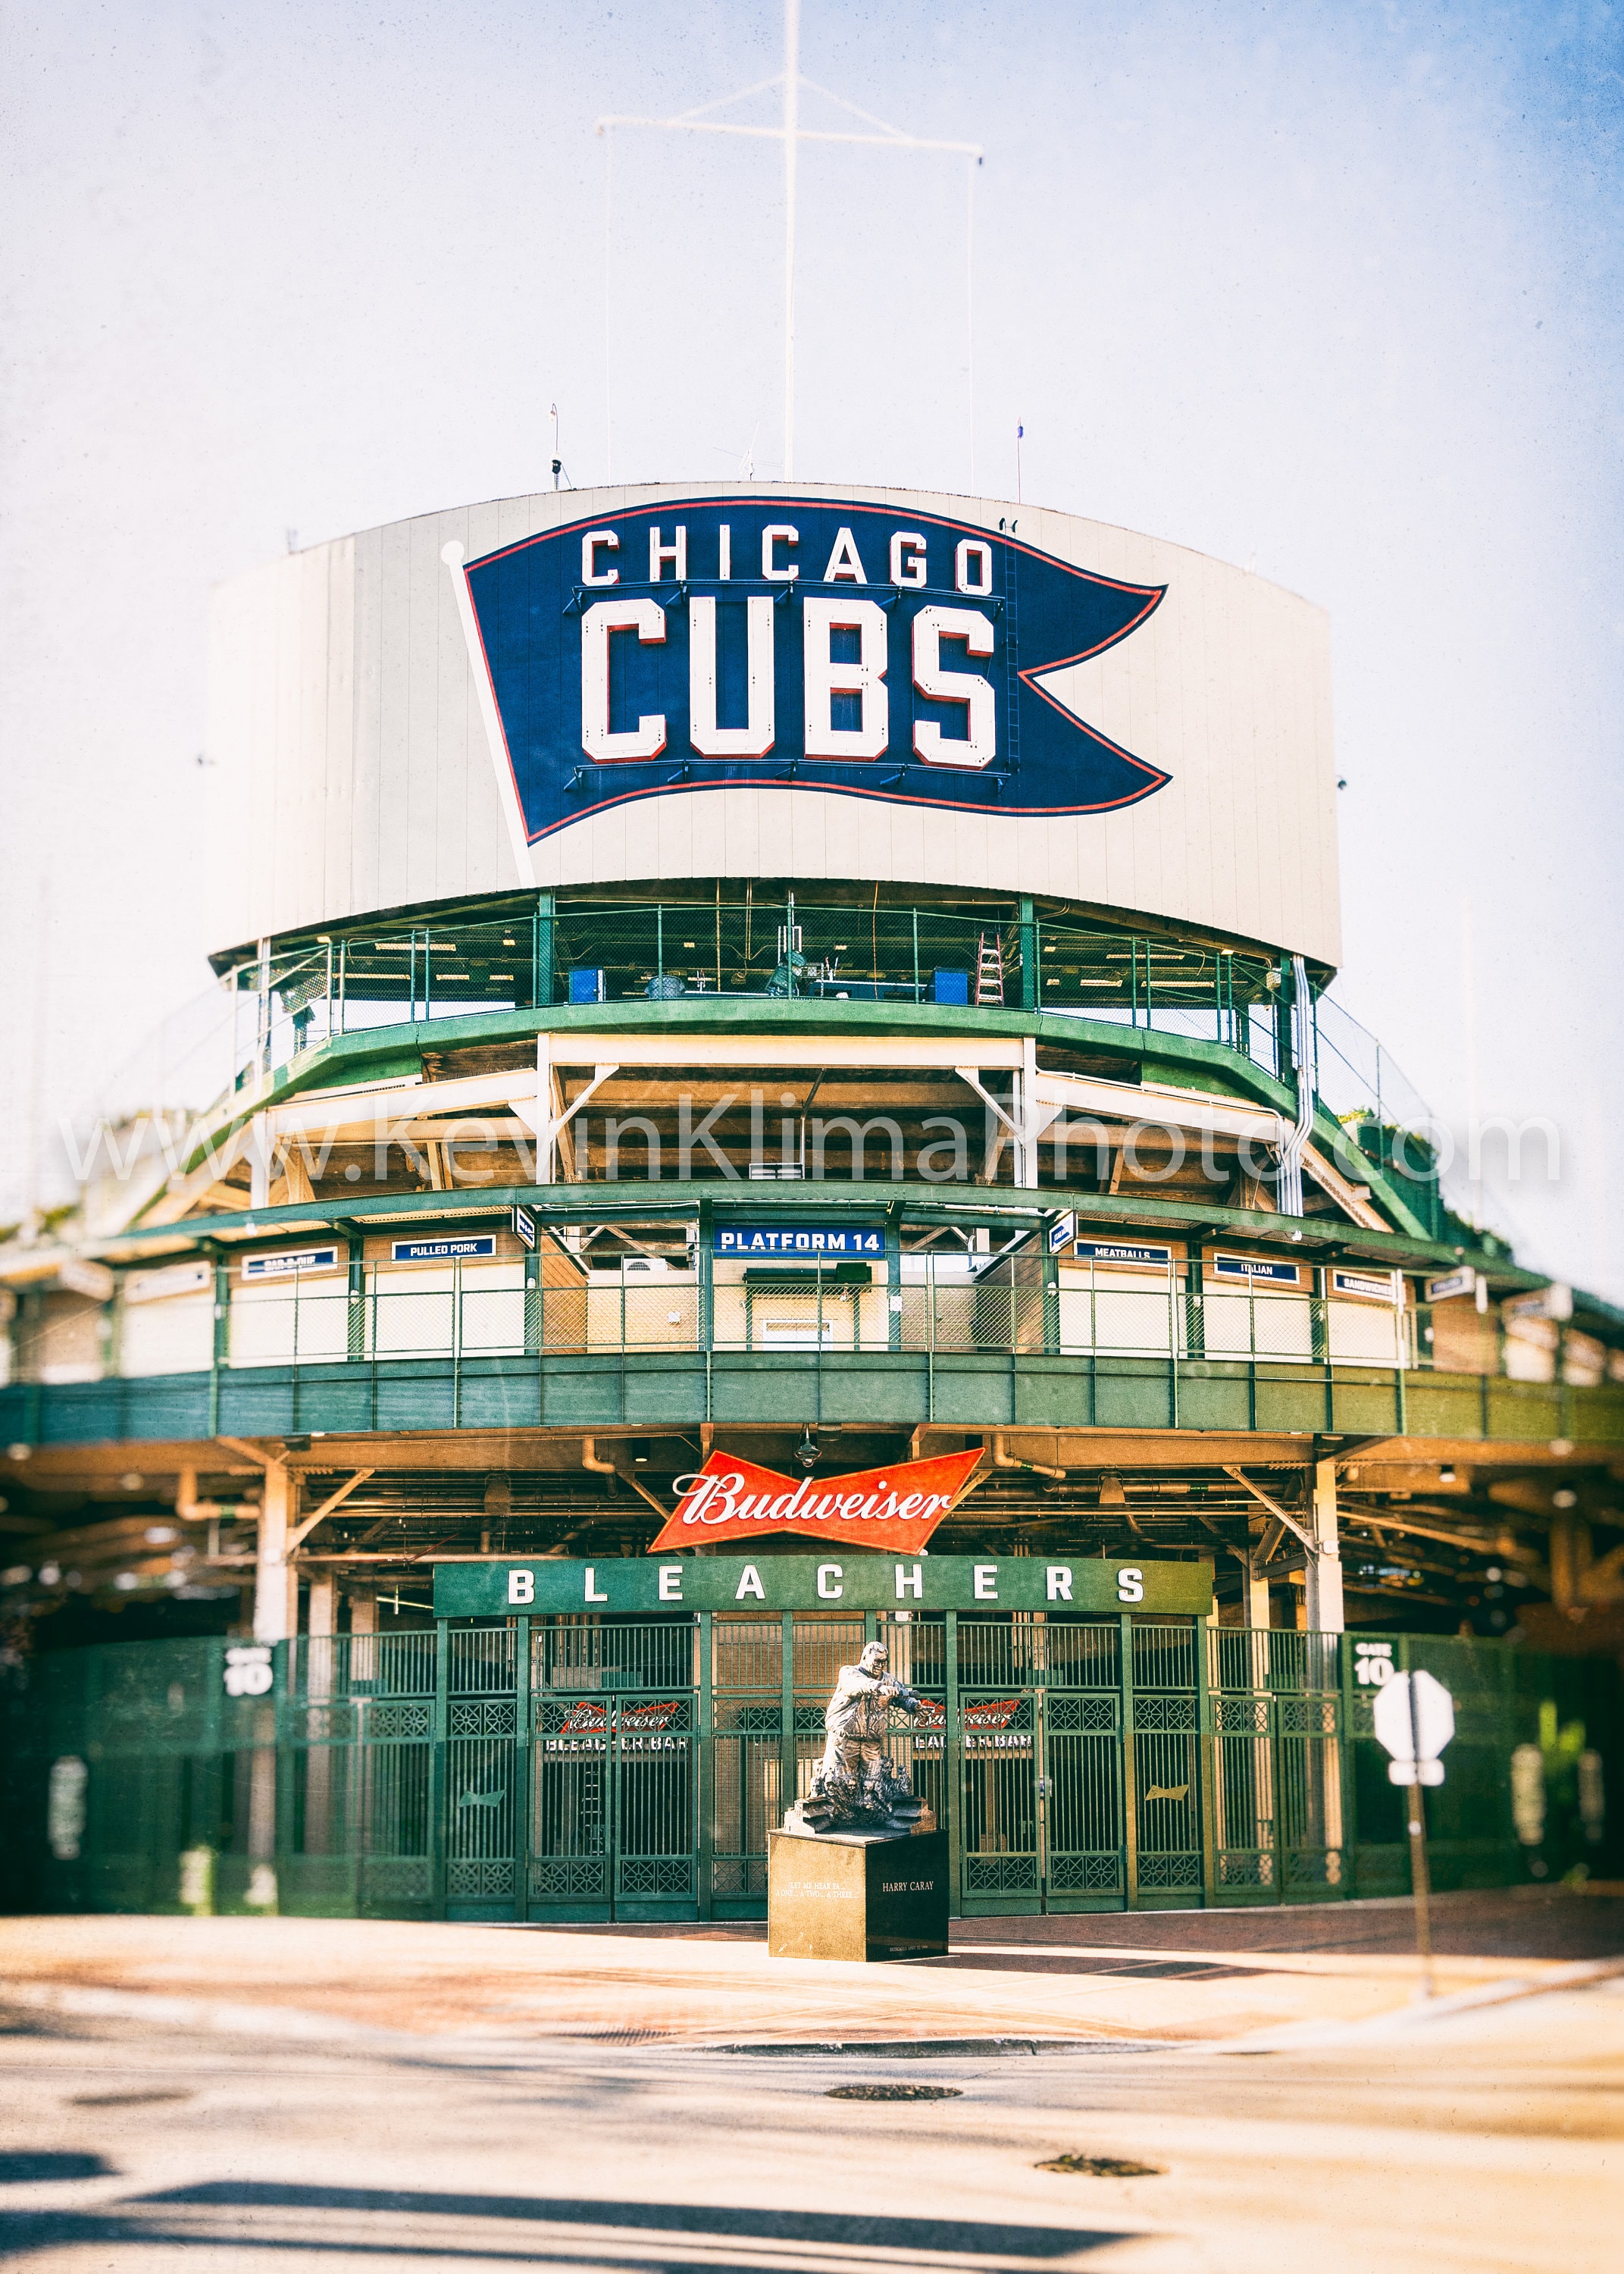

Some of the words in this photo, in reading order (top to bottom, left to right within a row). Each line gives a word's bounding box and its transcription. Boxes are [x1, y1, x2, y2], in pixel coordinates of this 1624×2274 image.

[580, 524, 993, 596] CHICAGO
[581, 597, 995, 770] CUBS
[410, 1244, 448, 1256] PULLED
[450, 1242, 477, 1254] PORK
[721, 1233, 846, 1251] PLATFORM
[853, 1233, 879, 1251] 14
[1094, 1247, 1150, 1258] MEATBALLS
[1241, 1263, 1273, 1275] ITALIAN
[671, 1473, 953, 1524] Budweiser
[508, 1564, 1145, 1604] BLEACHERS
[1355, 1643, 1392, 1657] GATE
[1354, 1657, 1394, 1687] 10
[882, 1882, 908, 1892] HARRY
[909, 1881, 934, 1891] CARAY
